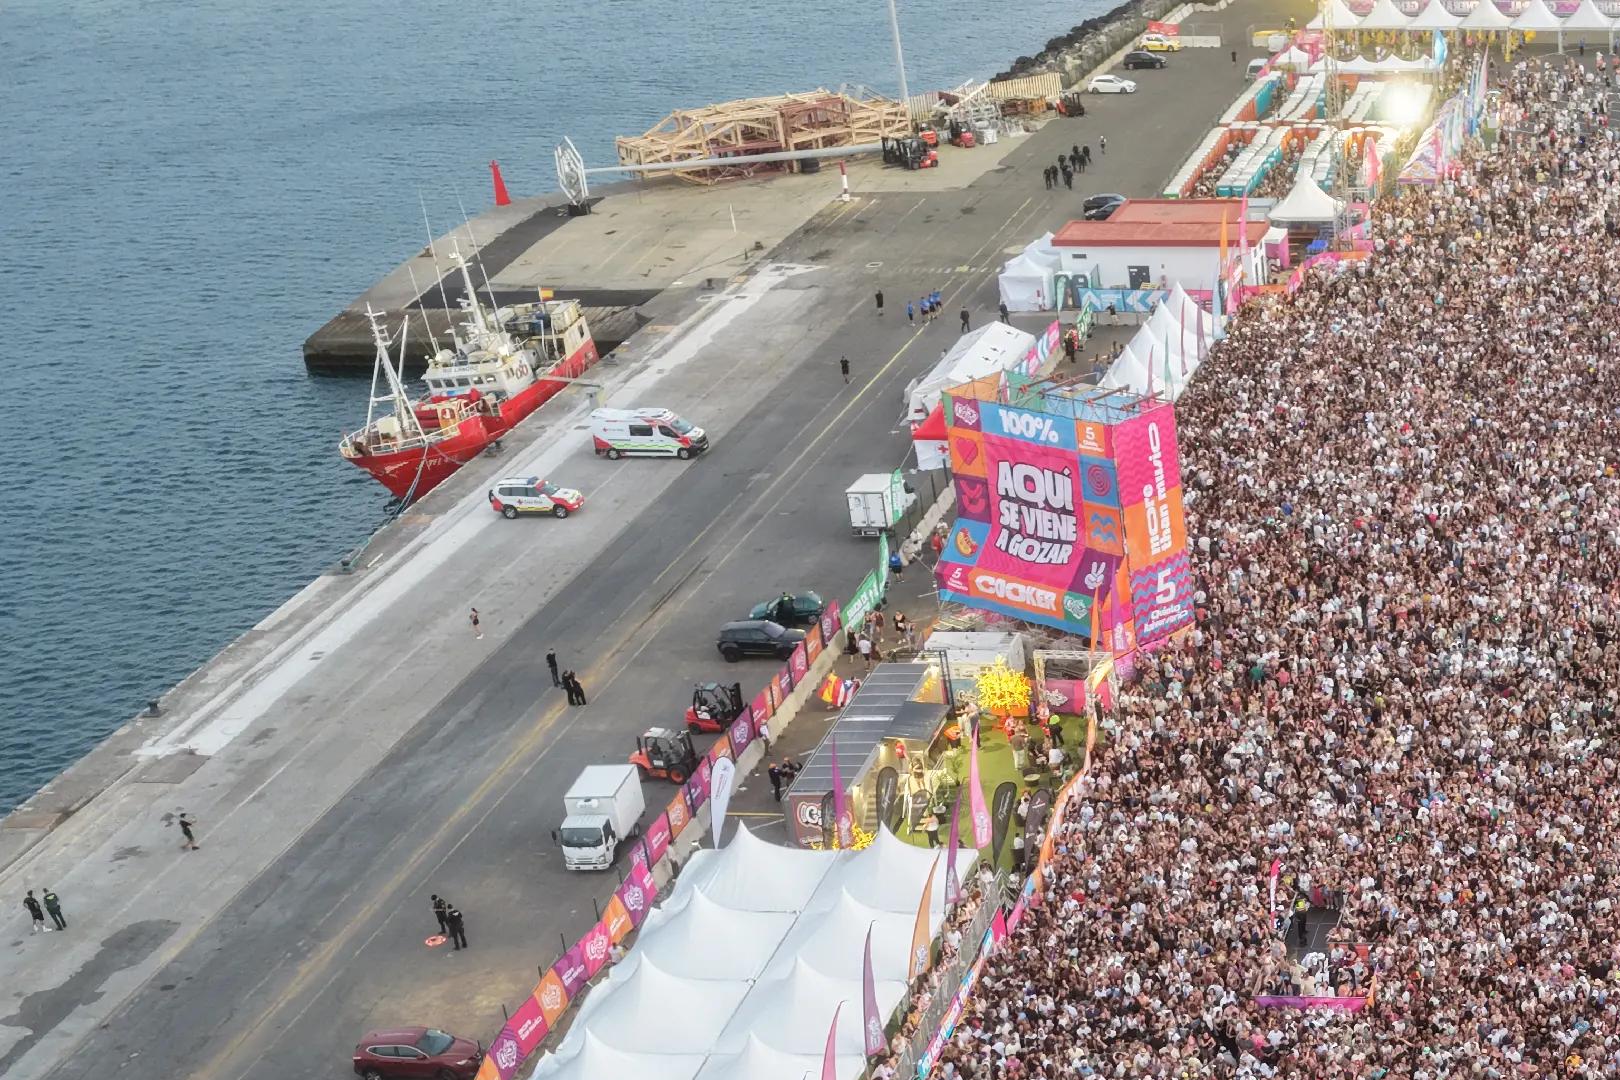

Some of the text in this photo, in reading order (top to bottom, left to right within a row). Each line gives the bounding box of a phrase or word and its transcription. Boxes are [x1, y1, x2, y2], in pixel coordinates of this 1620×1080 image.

[999, 408, 1059, 443] 100%
[998, 461, 1073, 511] AQUÍ
[1000, 500, 1077, 541] SE VIENE
[1143, 484, 1161, 555] more
[996, 529, 1073, 564] A GOZAR
[975, 575, 1057, 611] COOKER
[1156, 568, 1176, 604] 5
